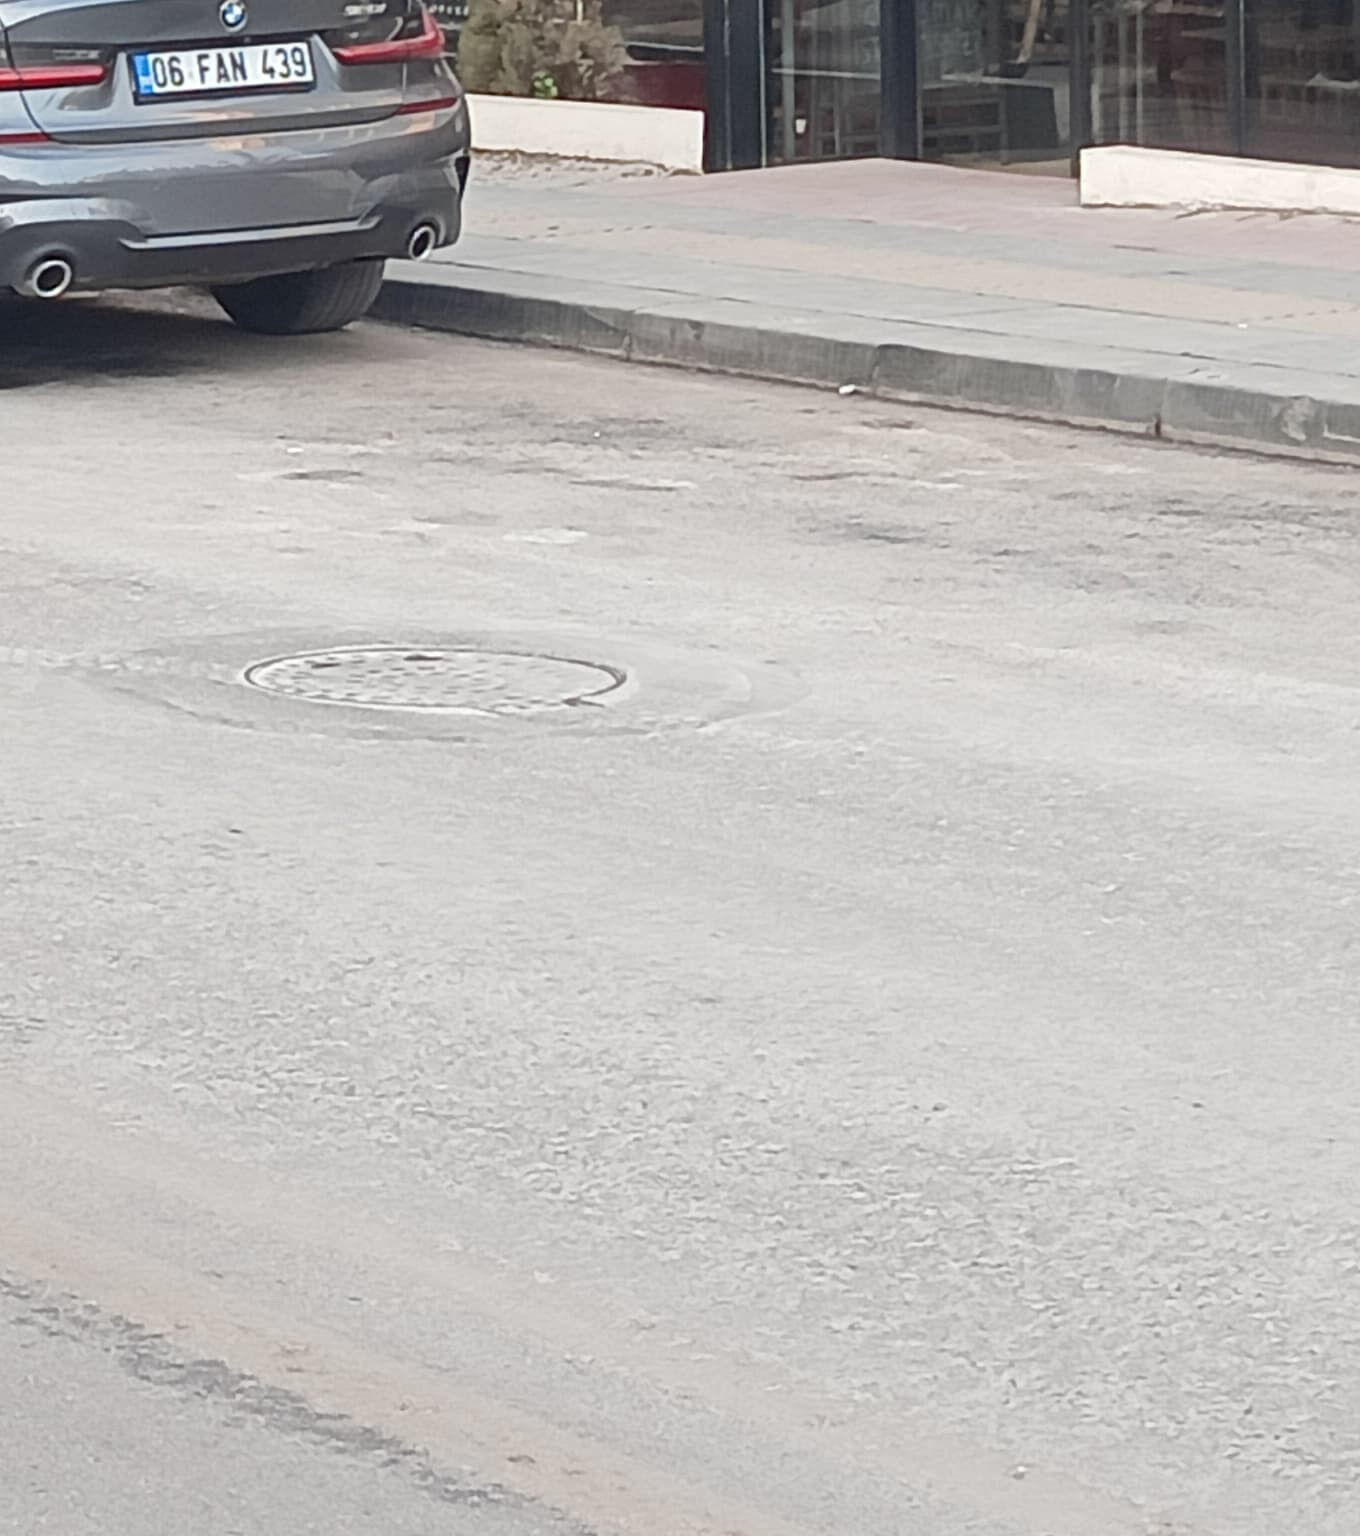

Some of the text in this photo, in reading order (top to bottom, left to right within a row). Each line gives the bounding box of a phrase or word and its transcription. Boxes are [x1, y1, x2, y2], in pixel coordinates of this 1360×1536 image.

[151, 47, 307, 89] 06 FAN 439
